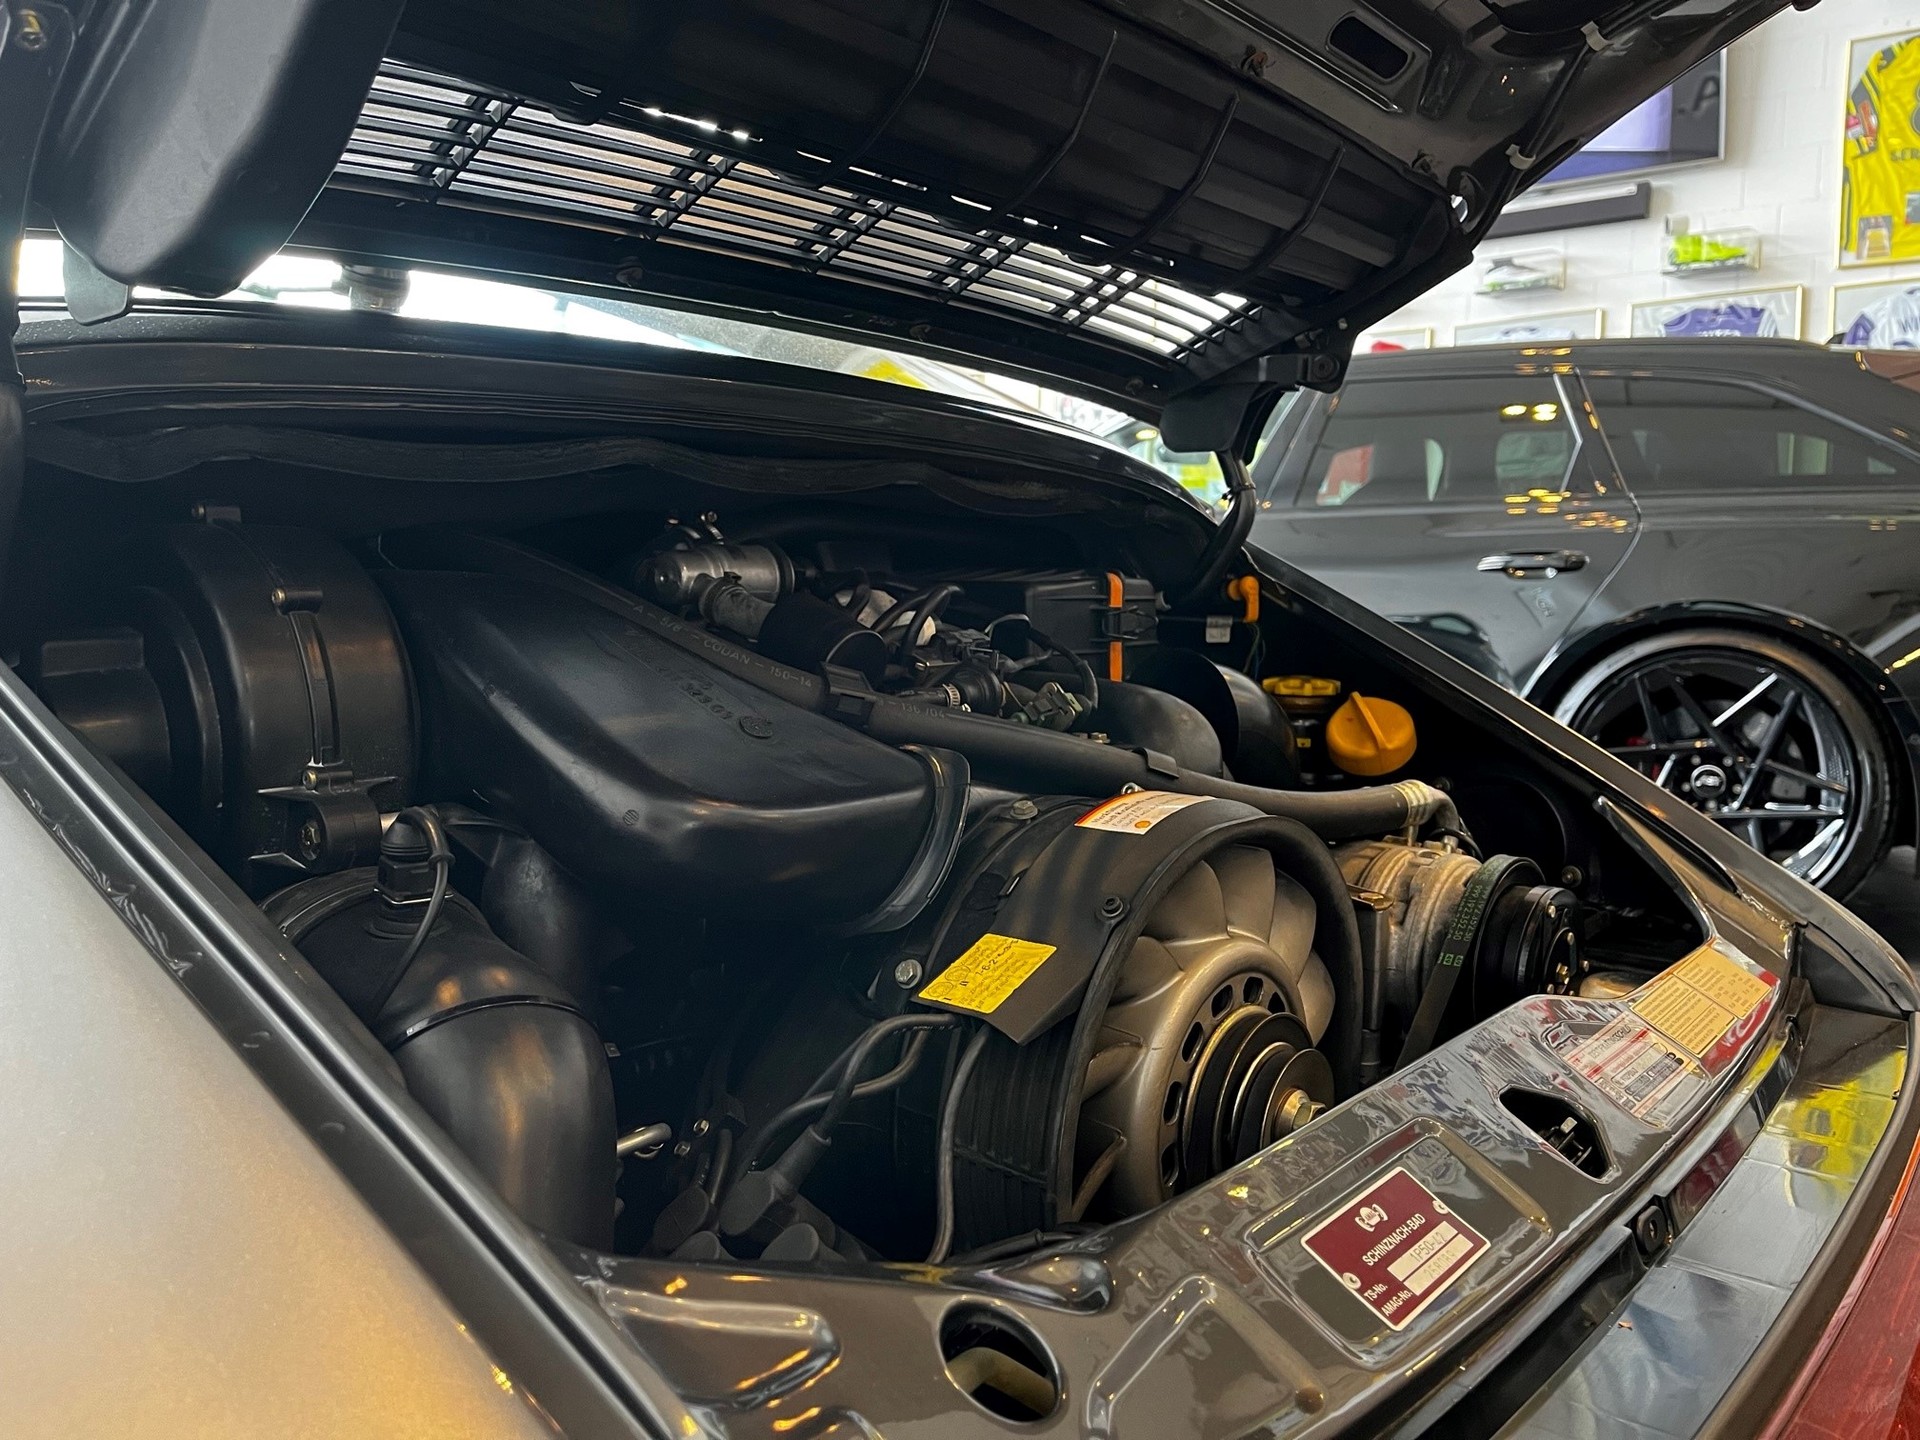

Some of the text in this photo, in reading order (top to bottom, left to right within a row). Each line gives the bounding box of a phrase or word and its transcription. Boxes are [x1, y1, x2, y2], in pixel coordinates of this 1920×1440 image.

[1361, 1213, 1426, 1267] SCHINZNACH-BAD
[1363, 1281, 1389, 1302] TS-No.
[1380, 1289, 1413, 1317] AMAG-No.
